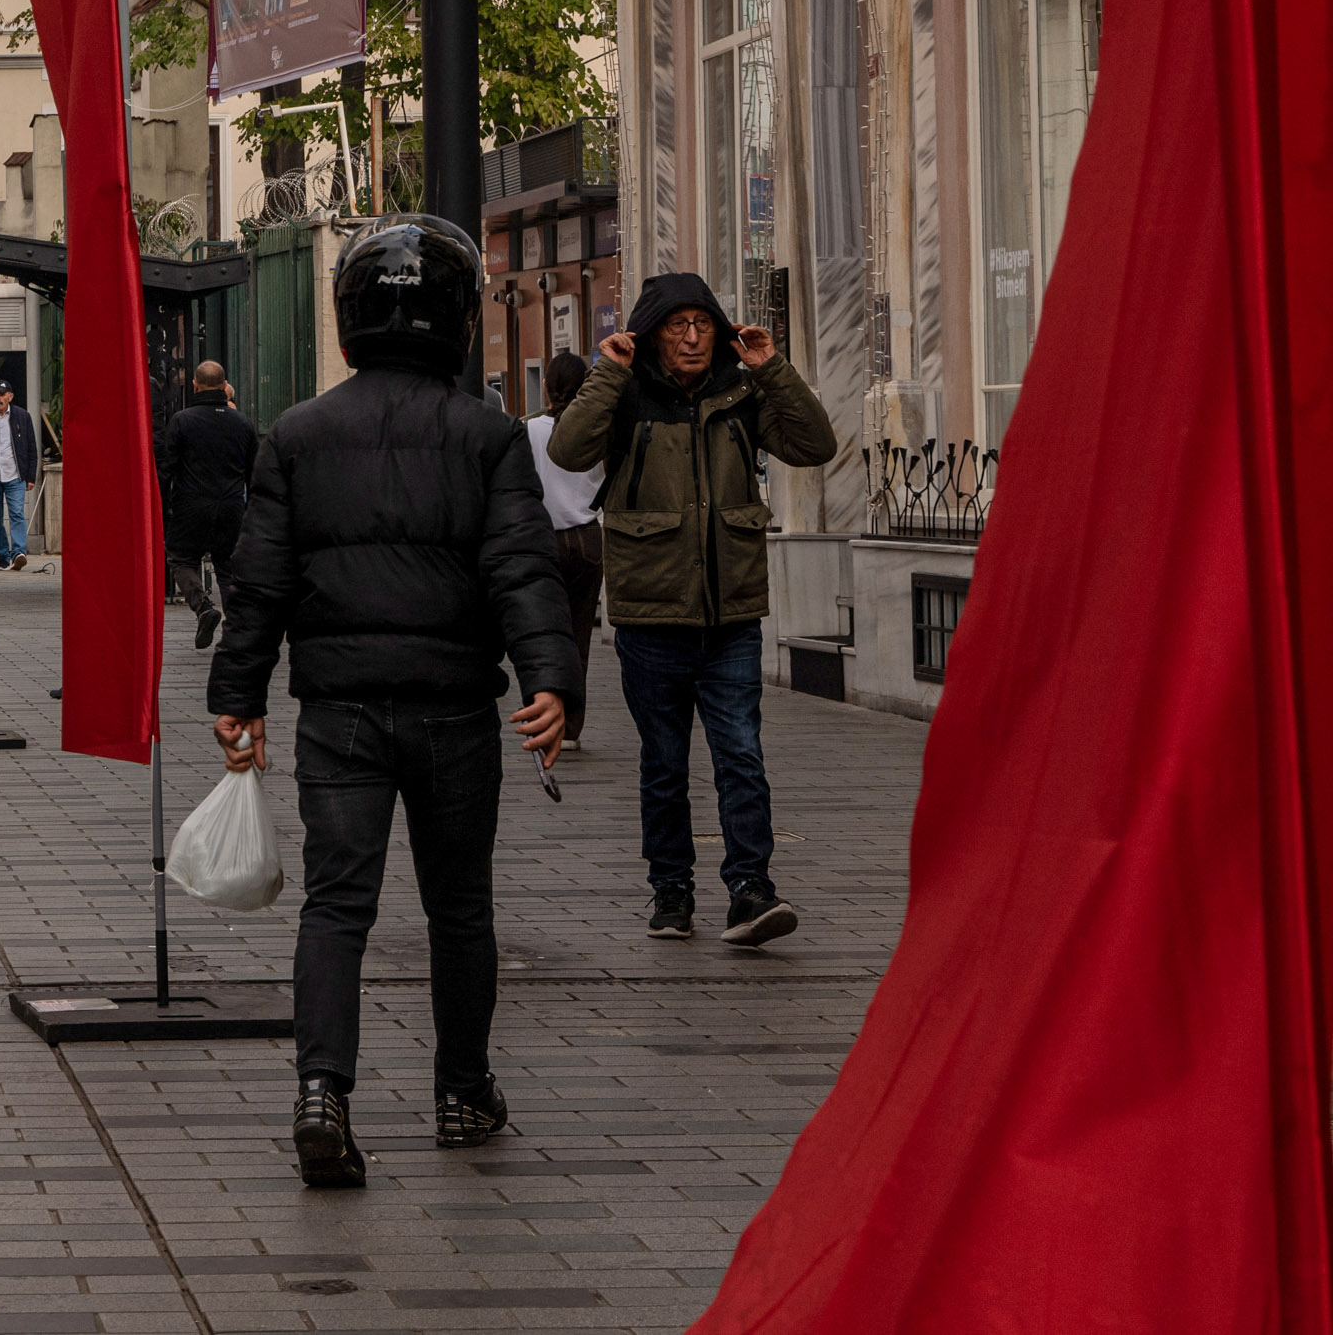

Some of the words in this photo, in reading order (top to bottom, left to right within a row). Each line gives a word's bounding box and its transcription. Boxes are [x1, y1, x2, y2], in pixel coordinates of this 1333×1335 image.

[989, 247, 1030, 274] #Hikayem
[377, 275, 421, 285] NCR
[995, 272, 1026, 299] Bitmedi
